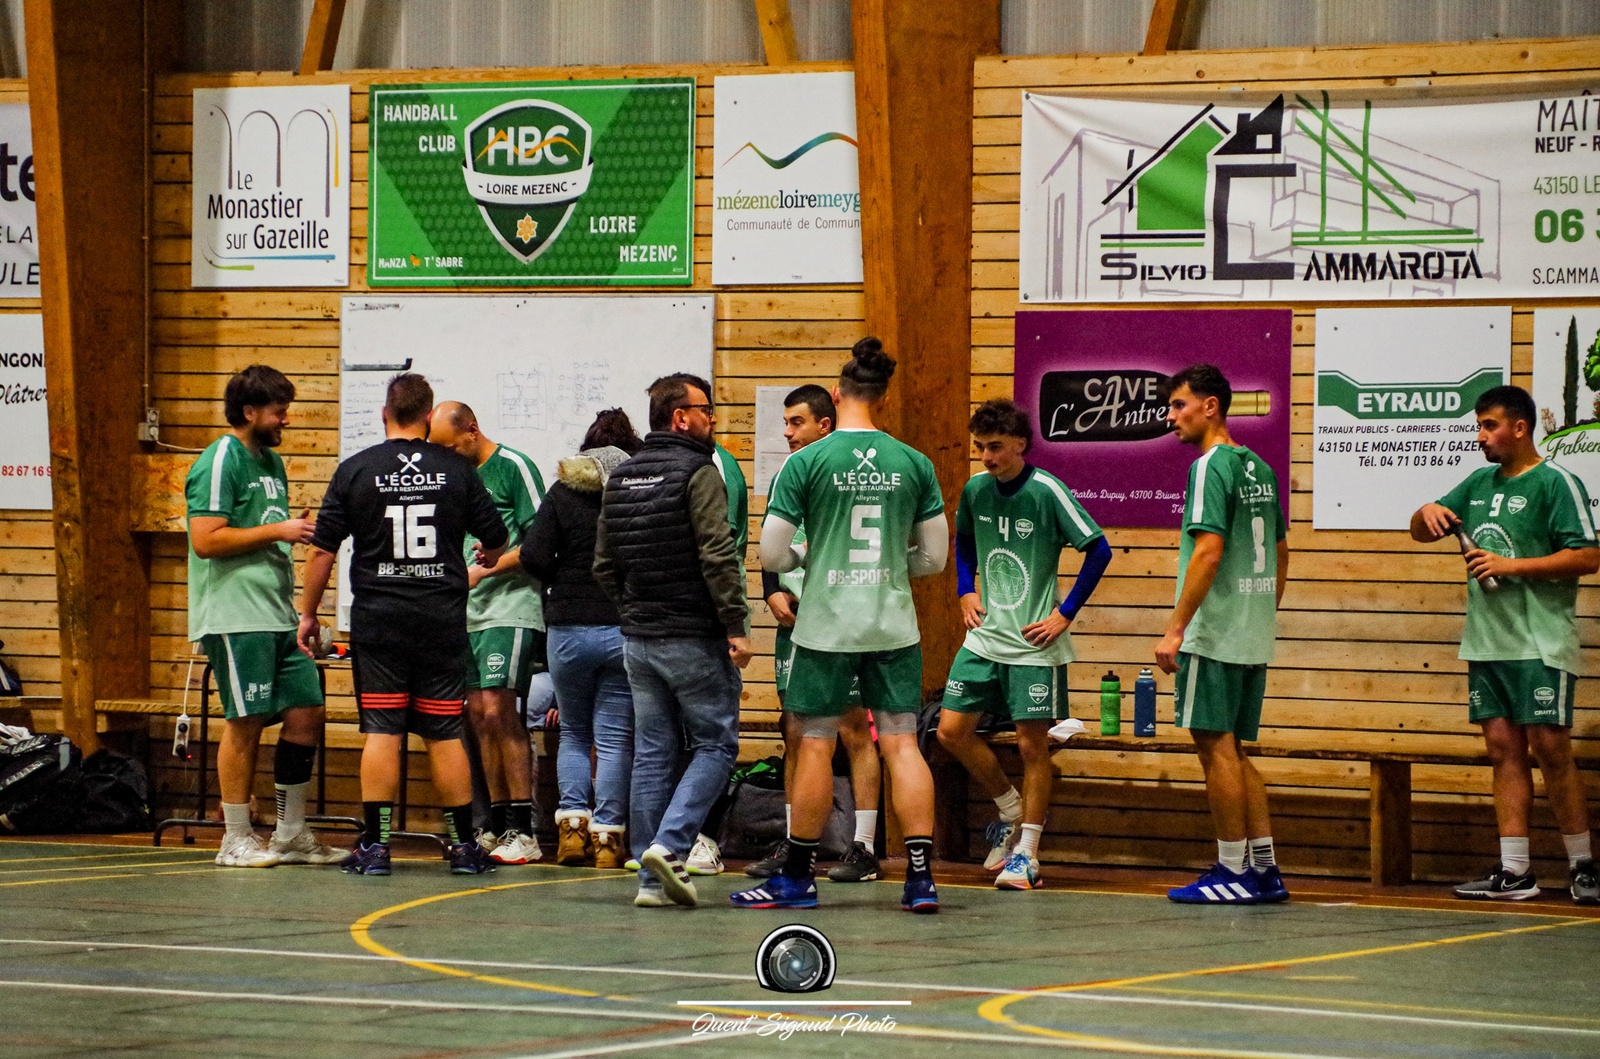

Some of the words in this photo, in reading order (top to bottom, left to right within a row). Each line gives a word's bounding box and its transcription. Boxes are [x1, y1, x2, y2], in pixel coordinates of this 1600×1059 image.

[384, 104, 458, 121] HANDBALL
[419, 135, 456, 152] CLUB
[488, 125, 570, 166] HBC
[1535, 136, 1576, 153] NEUF
[237, 170, 253, 190] Le
[487, 182, 518, 195] LOIRE
[522, 181, 568, 195] MEZENC
[1534, 176, 1578, 194] 43150
[207, 191, 303, 219] Monastier
[589, 216, 636, 233] LOIRE
[727, 218, 792, 231] Communauté
[798, 218, 810, 229] de
[1535, 208, 1585, 243] 06
[226, 231, 248, 250] sur
[253, 221, 329, 250] Gazeille
[424, 256, 464, 267] T'SABRE
[619, 245, 678, 262] MEZENC
[1532, 267, 1600, 285] S.CAMMA
[1357, 391, 1461, 413] EYRAUD
[1318, 425, 1355, 434] TRAVAUX
[1355, 425, 1389, 434] PUBLICS
[1396, 425, 1441, 433] CARRIERES
[1318, 442, 1352, 453] 43150
[1355, 442, 1368, 452] LE
[1371, 441, 1437, 452] MONASTIER
[1359, 455, 1377, 467] Tél.
[1380, 456, 1393, 466] 04
[1397, 456, 1409, 466] 71
[1413, 456, 1427, 466] 03
[1430, 456, 1444, 466] 86
[1446, 455, 1461, 466] 49
[2, 465, 14, 477] 82
[16, 465, 29, 477] 67
[32, 465, 44, 477] 16
[375, 471, 447, 487] L'ÉCOLE
[832, 469, 901, 486] L'ÉCOLE
[1129, 489, 1154, 500] 43700
[1154, 489, 1181, 500] Brives
[1489, 493, 1505, 517] 9
[384, 503, 437, 559] 16
[849, 504, 881, 563] 5
[998, 515, 1010, 542] 4
[378, 562, 445, 578] BB-SPORTS
